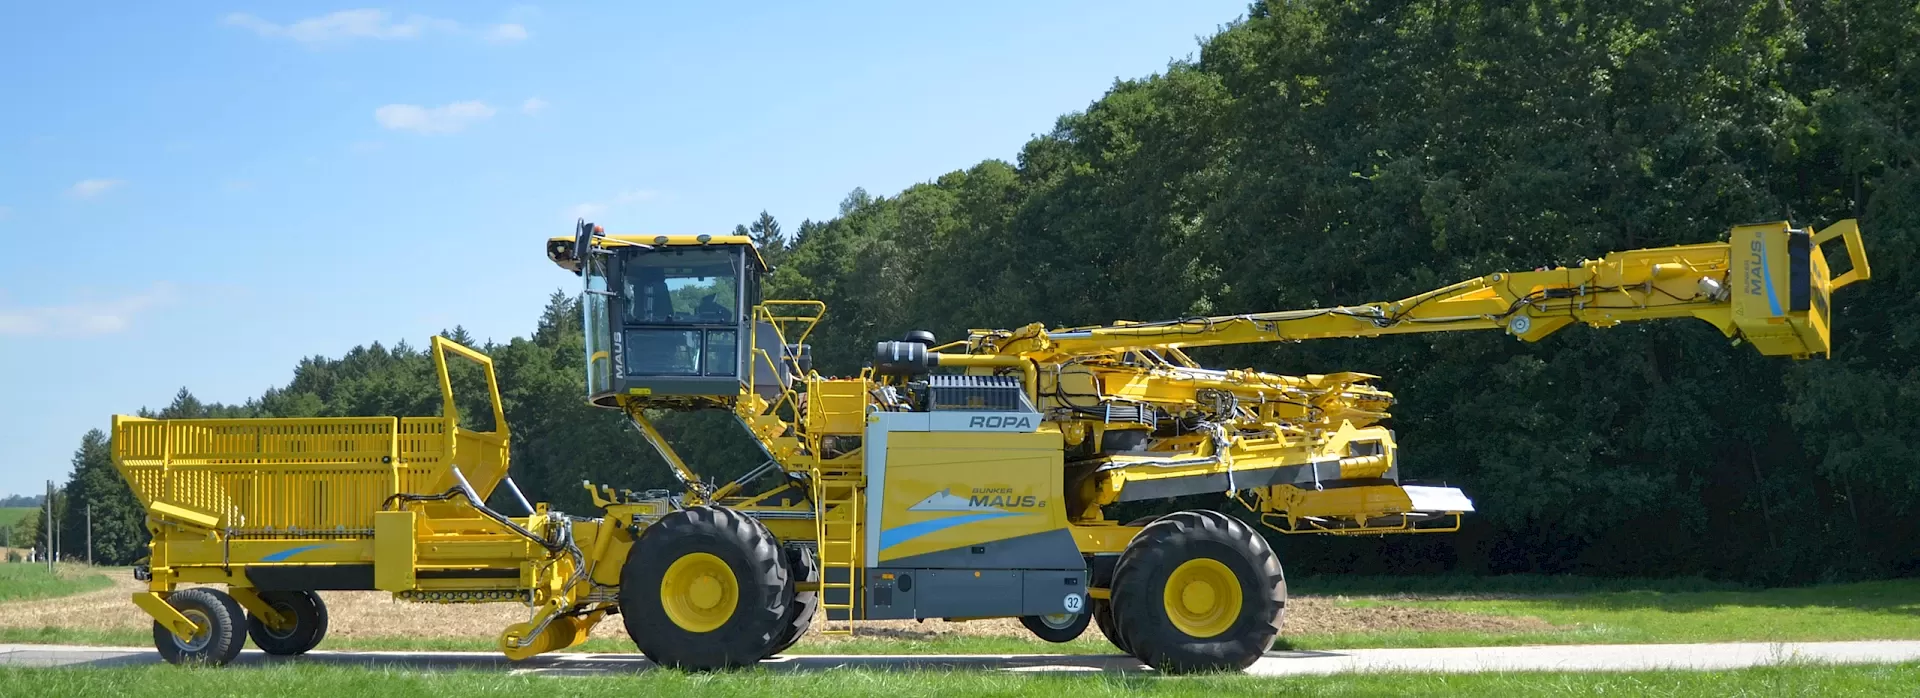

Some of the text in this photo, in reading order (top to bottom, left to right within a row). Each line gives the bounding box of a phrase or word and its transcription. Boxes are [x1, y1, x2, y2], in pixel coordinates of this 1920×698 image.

[1751, 240, 1762, 296] MAUS
[613, 331, 623, 379] MAUS
[969, 416, 1031, 428] ROPA
[968, 495, 1036, 507] MAUS
[1067, 597, 1079, 609] 32
